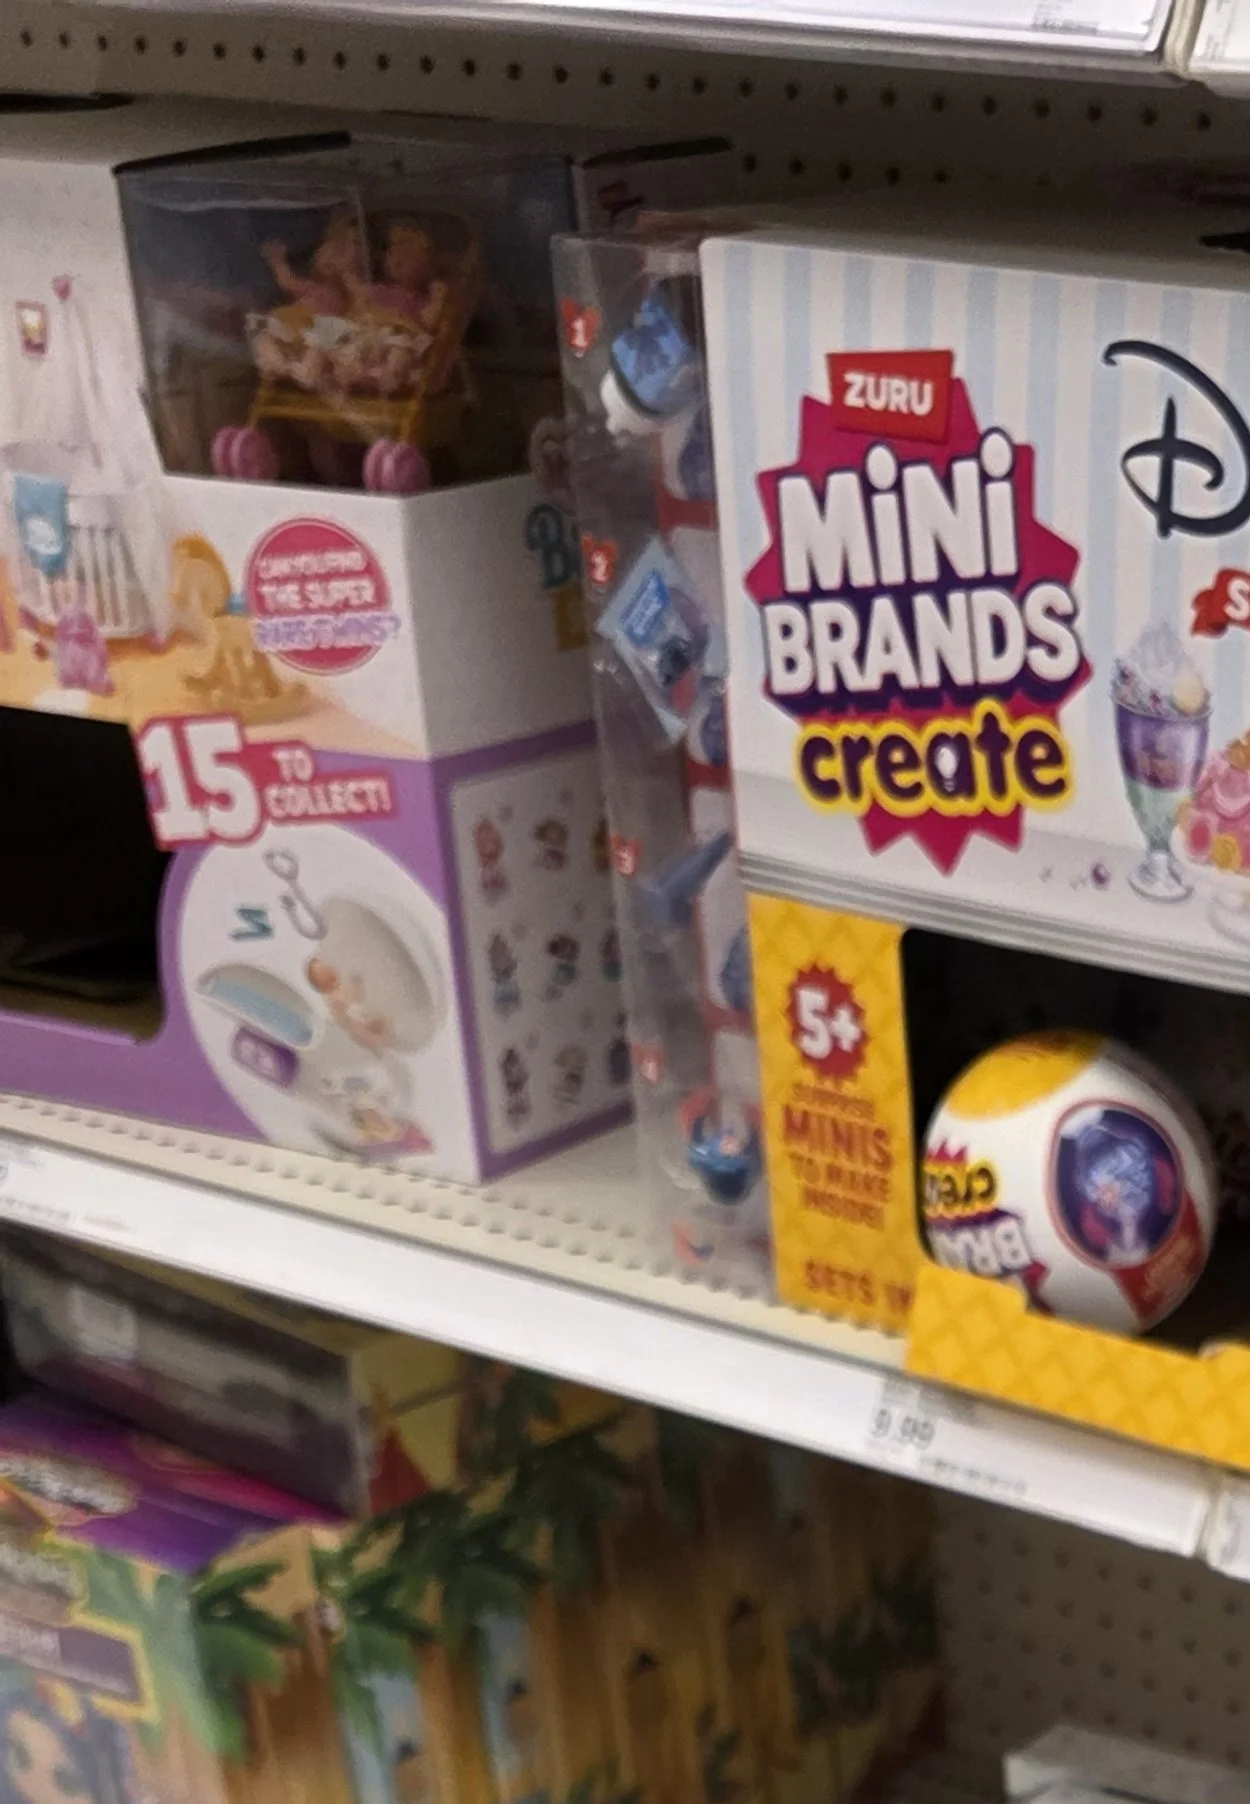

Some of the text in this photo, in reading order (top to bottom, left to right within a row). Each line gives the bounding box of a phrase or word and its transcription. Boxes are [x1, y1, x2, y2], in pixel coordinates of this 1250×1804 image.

[843, 372, 934, 416] ZURU
[764, 583, 1080, 696] BRANDS
[138, 720, 261, 844] 15
[271, 747, 315, 782] TO
[801, 712, 1066, 803] create
[264, 778, 393, 818] COLLECT!
[795, 985, 862, 1060] 5+
[783, 1104, 894, 1173] MINIS
